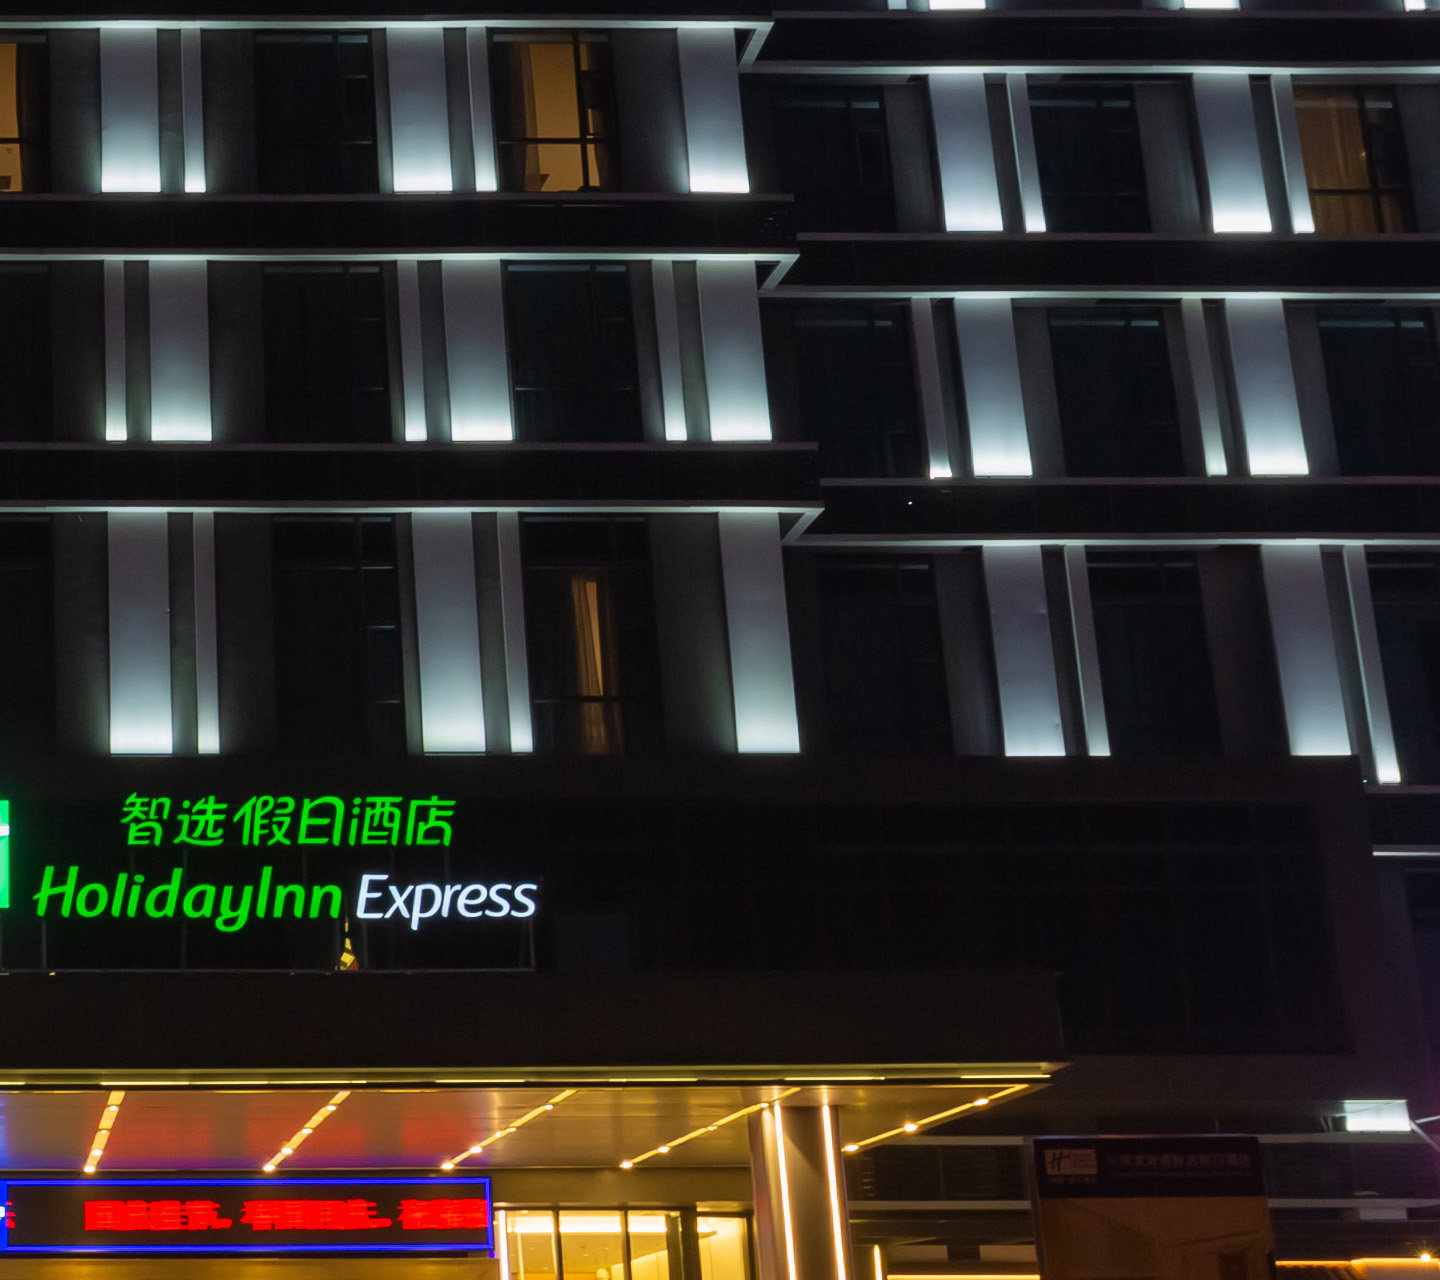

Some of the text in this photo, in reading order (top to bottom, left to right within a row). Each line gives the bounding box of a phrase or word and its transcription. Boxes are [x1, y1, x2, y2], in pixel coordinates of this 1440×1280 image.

[120, 792, 457, 847] 智选假日酒店
[356, 874, 538, 931] Express
